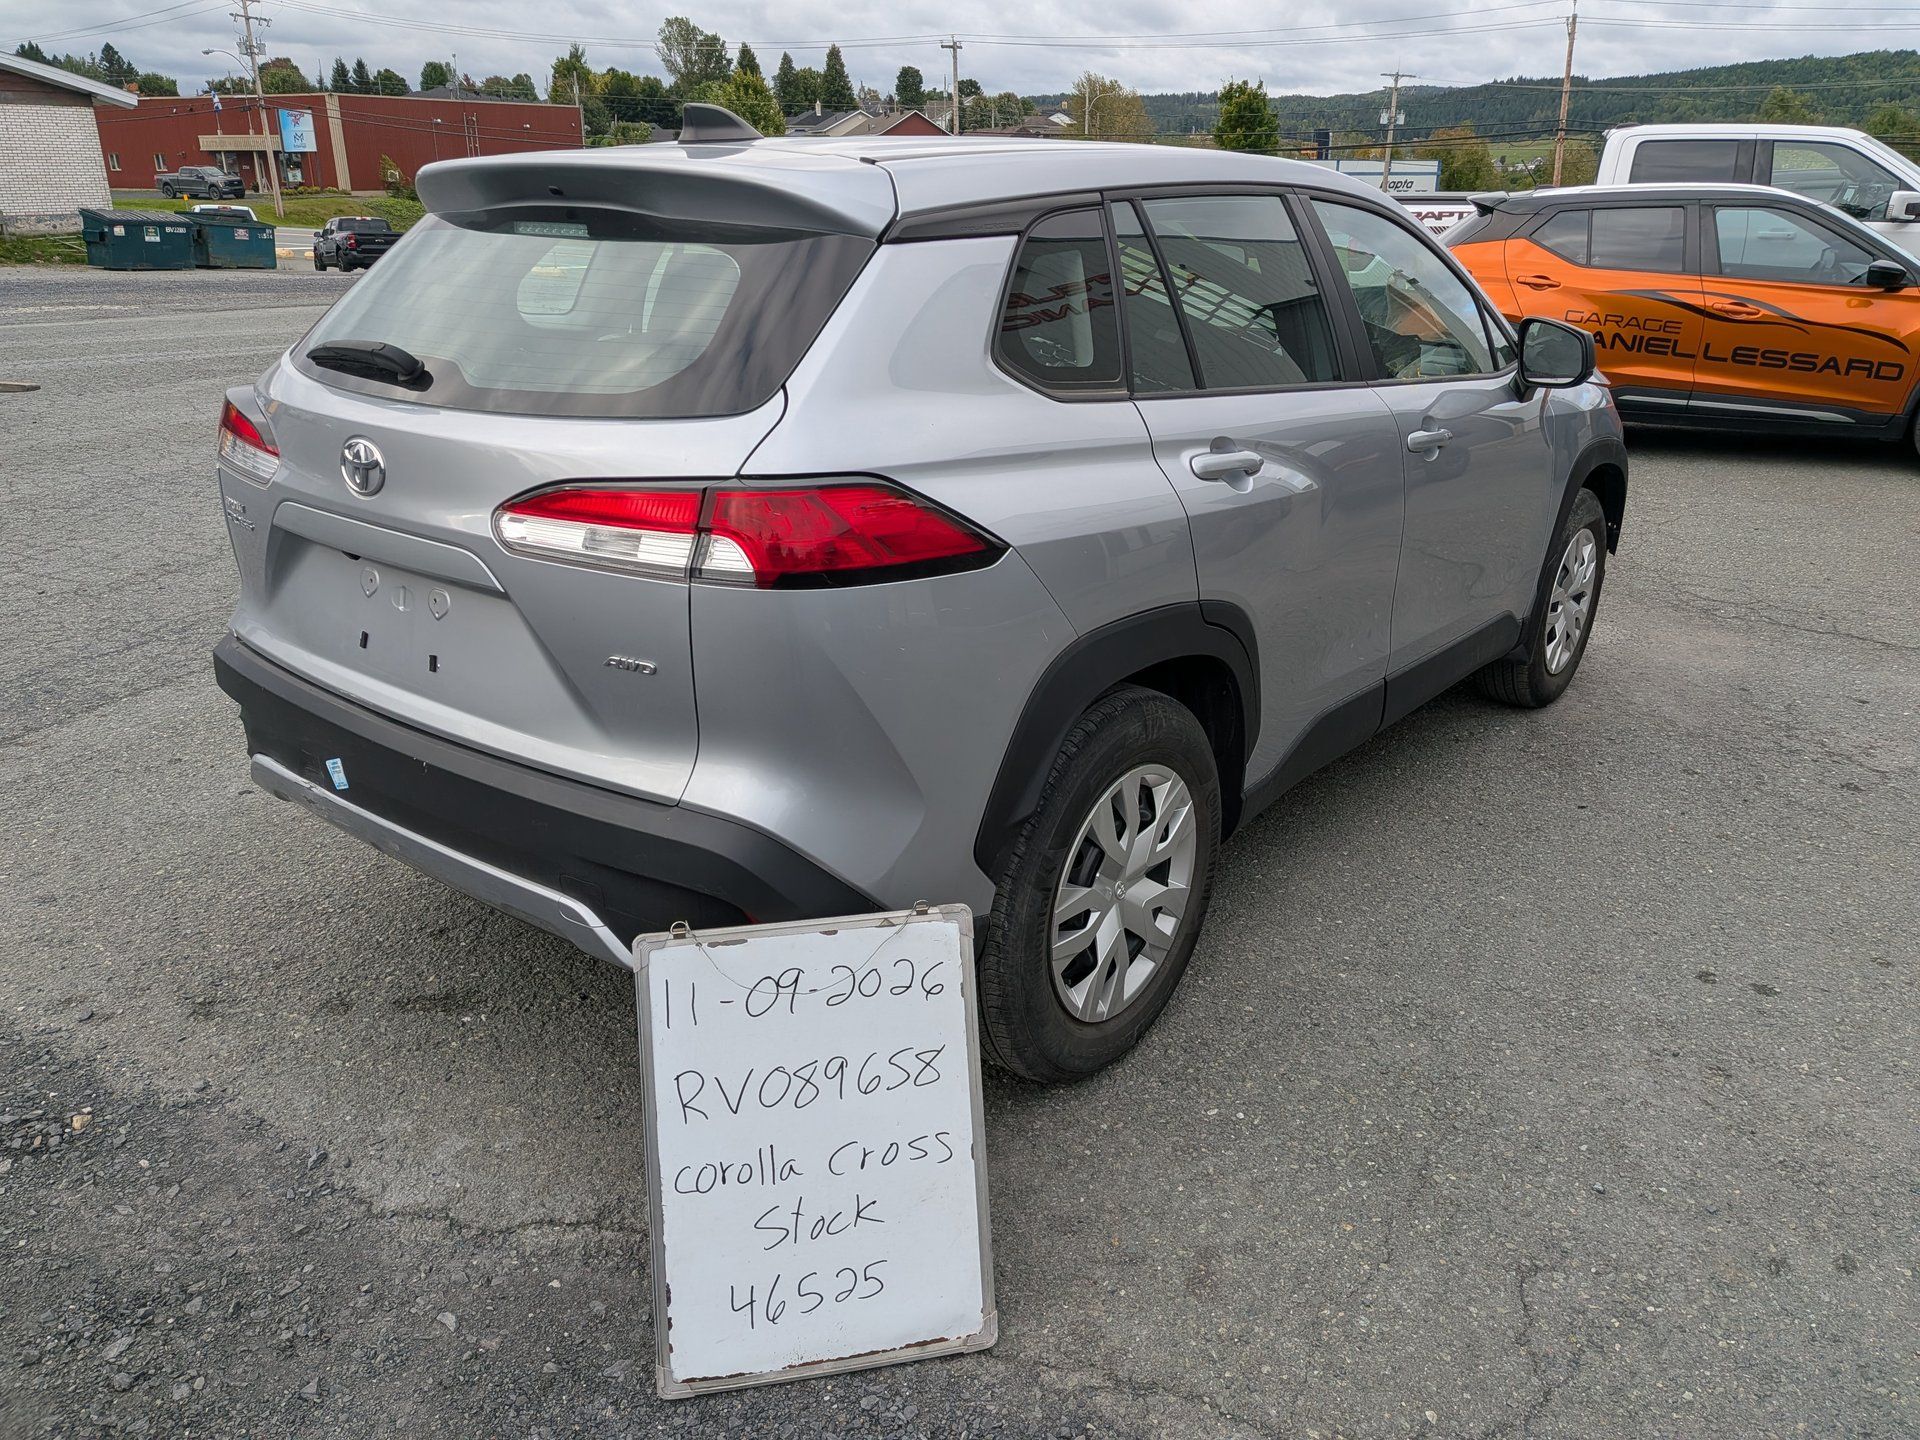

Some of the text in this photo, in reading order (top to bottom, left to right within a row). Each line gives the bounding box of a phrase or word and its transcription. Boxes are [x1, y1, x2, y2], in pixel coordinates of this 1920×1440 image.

[1564, 309, 1683, 334] GARAGE
[1595, 330, 1905, 382] ANIEL LESSARD
[602, 655, 657, 676] AWD
[665, 958, 945, 1029] 11-09-2026
[828, 1132, 953, 1176] Cross
[731, 1259, 888, 1329] 46525
